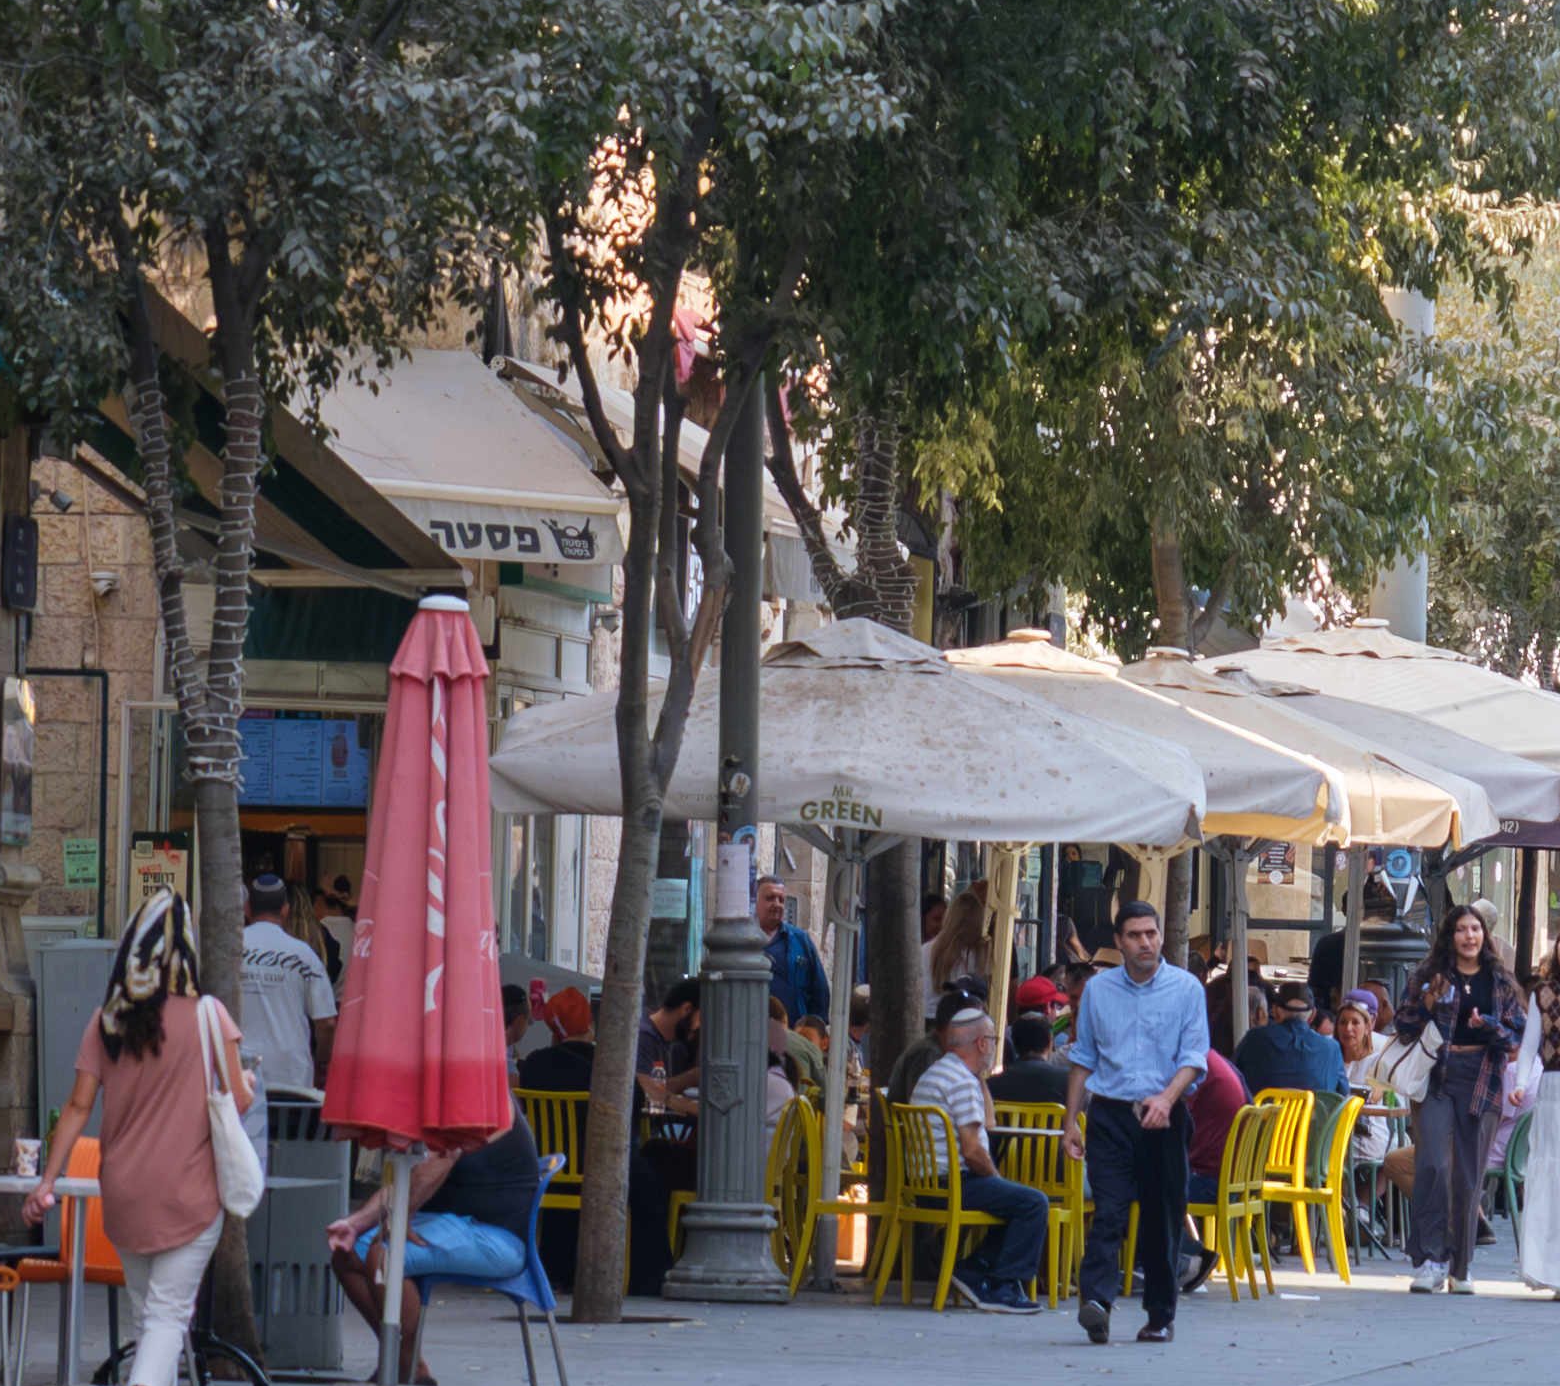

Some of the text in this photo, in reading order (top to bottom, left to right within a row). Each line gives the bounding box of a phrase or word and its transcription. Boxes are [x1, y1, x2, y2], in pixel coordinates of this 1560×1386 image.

[429, 520, 541, 553] פסטה
[831, 784, 854, 799] MR
[800, 800, 883, 828] GREEN
[143, 872, 175, 883] דרושים
